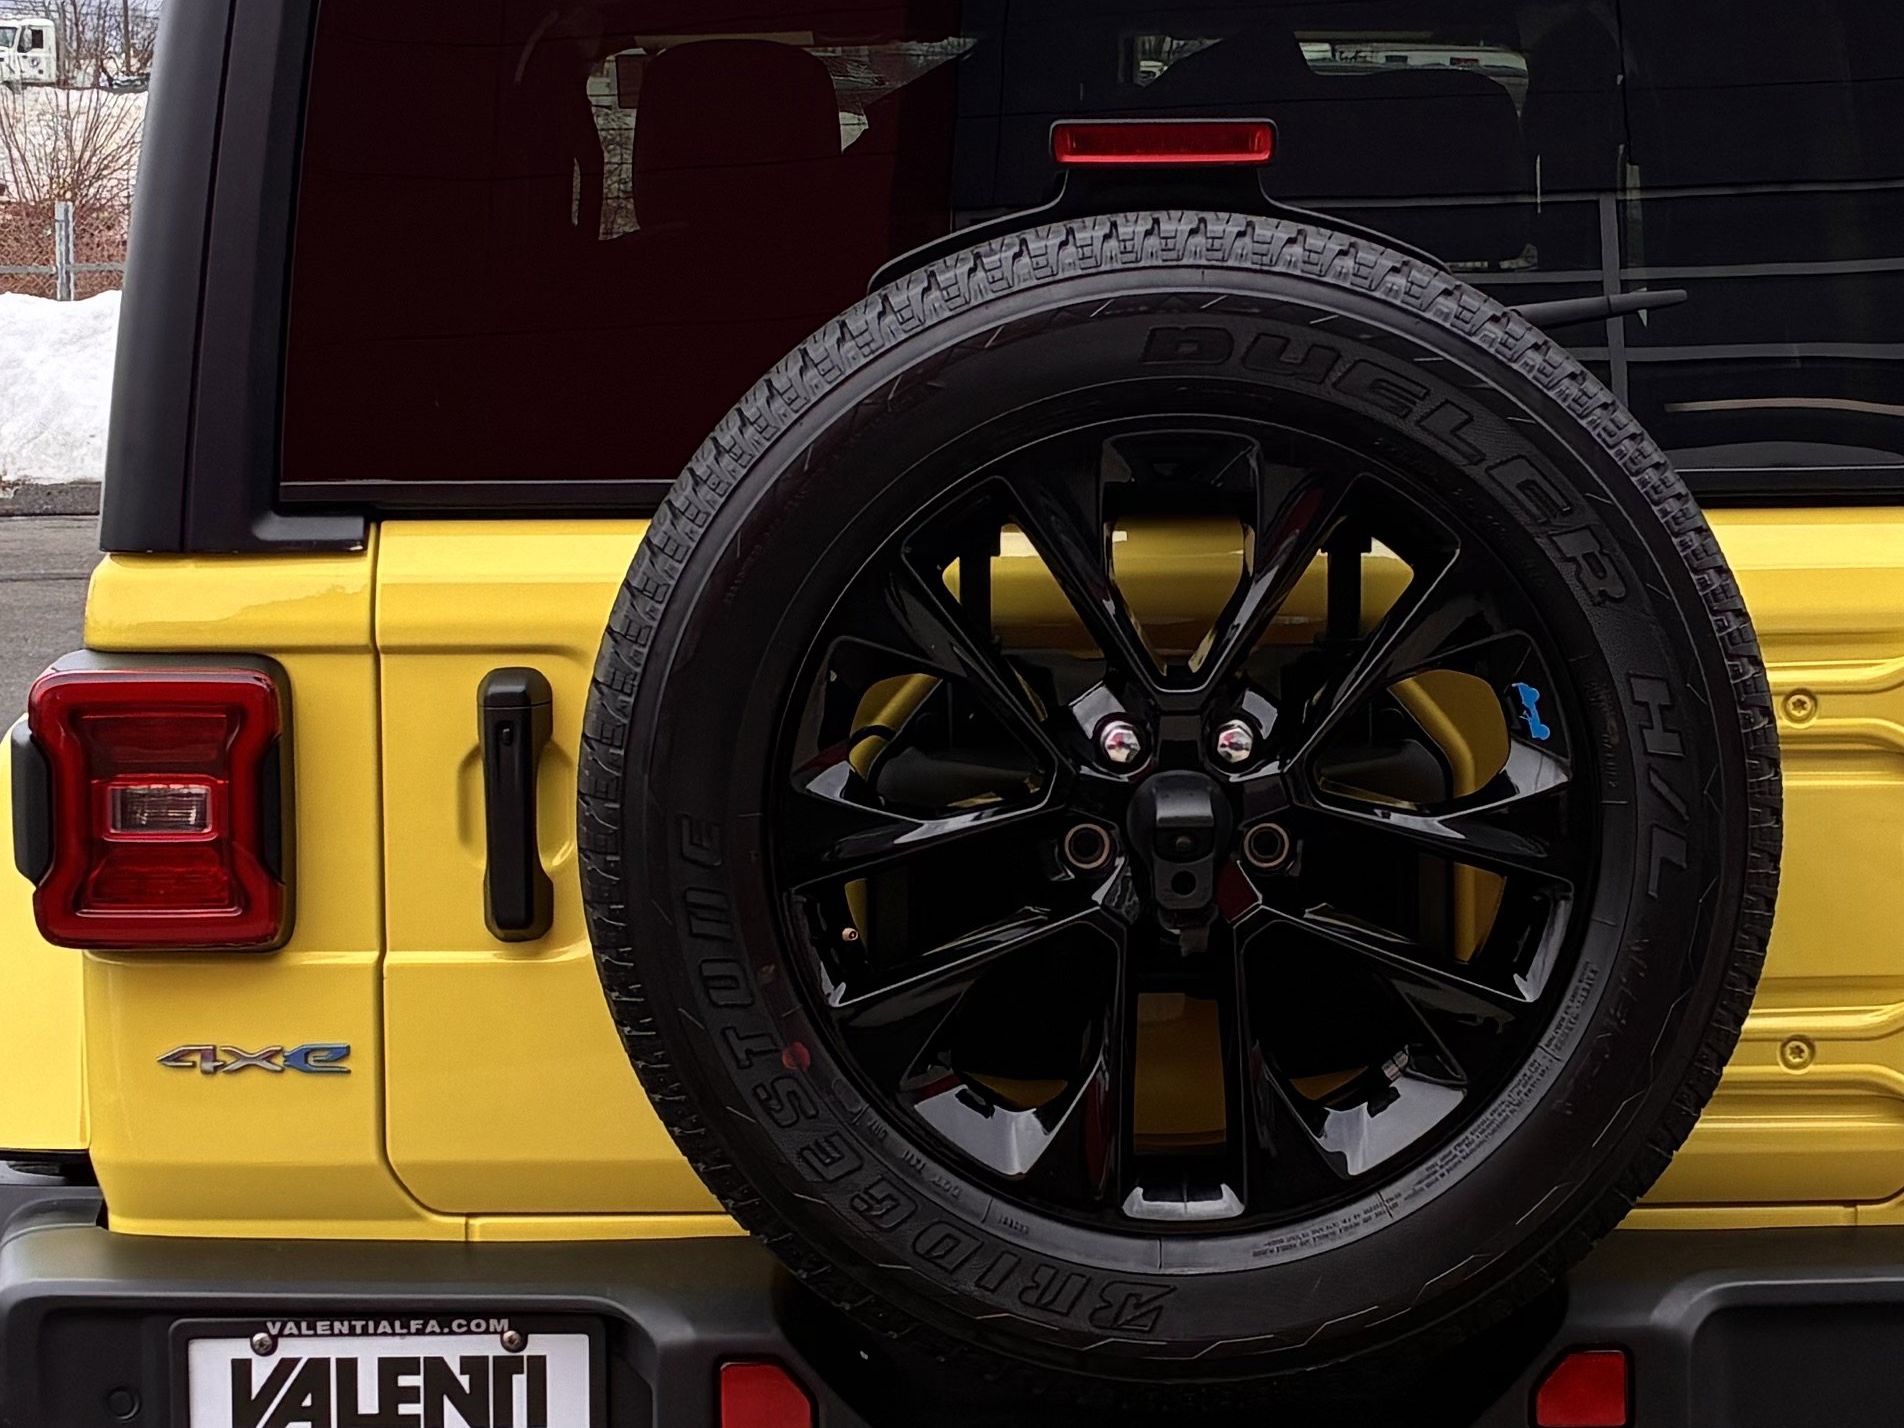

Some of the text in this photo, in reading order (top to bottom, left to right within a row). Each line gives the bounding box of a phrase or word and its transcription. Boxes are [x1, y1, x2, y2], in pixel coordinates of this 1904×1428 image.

[1139, 325, 1689, 899] DUELER H/L
[266, 1317, 510, 1336] VALENTIALFA.COM
[678, 810, 1177, 1332] BRIDGESTONE
